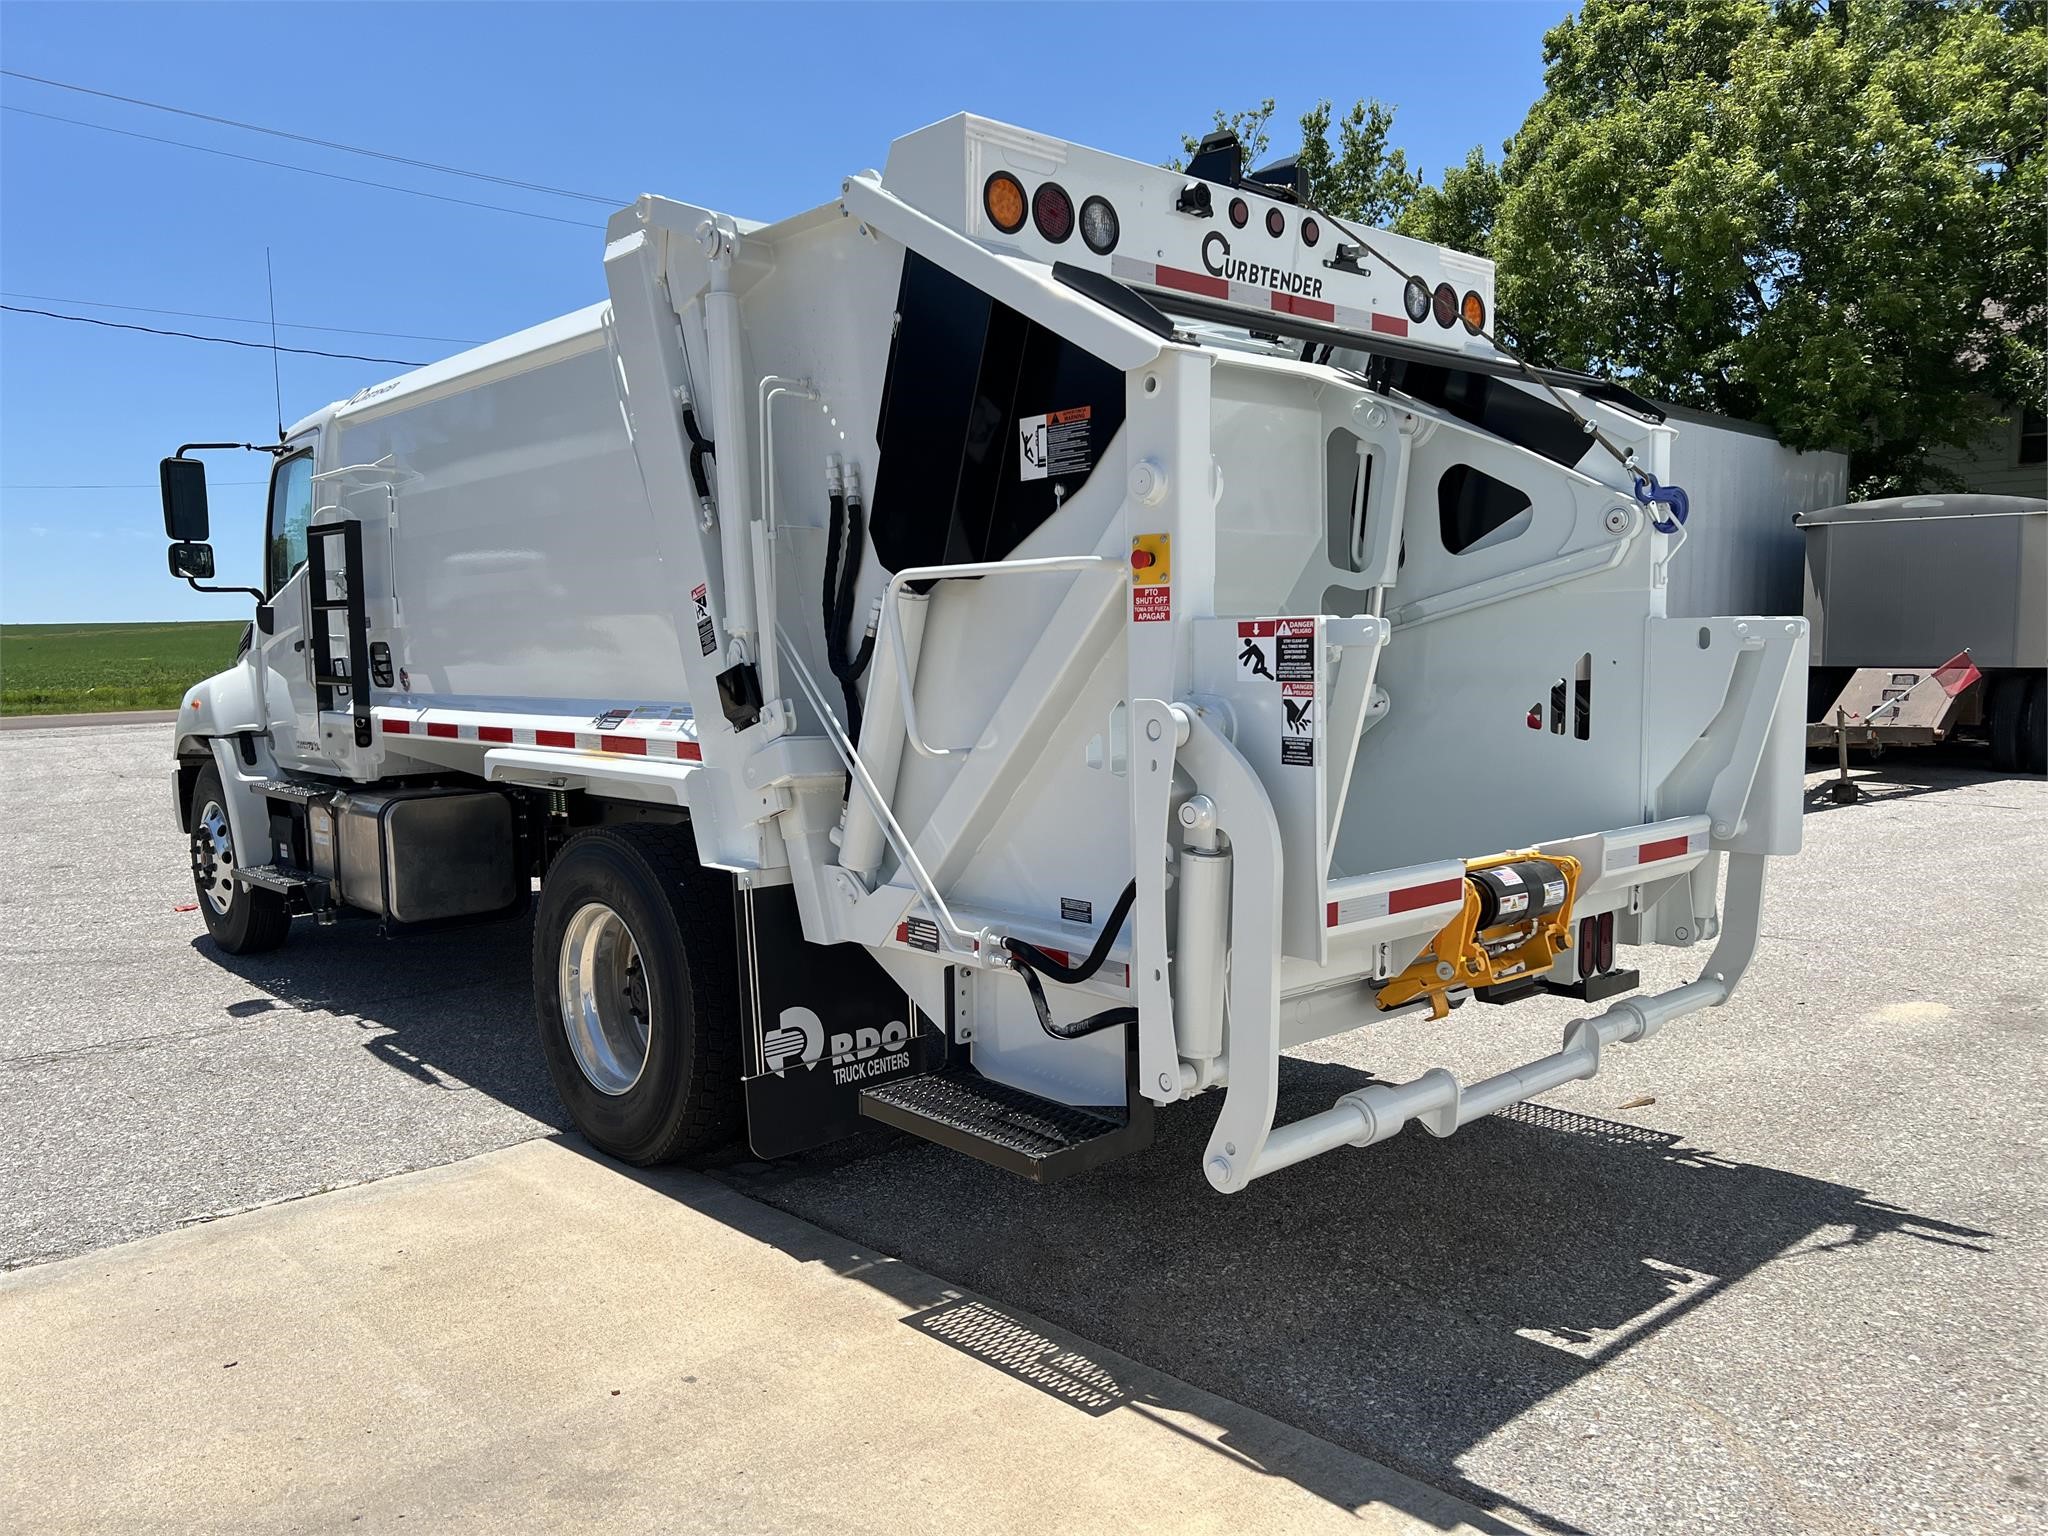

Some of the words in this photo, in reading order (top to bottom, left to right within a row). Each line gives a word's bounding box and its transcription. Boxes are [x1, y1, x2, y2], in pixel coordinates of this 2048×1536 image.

[1201, 230, 1323, 299] CURBTENDER
[1135, 597, 1153, 605] SHUT
[1154, 596, 1168, 604] OFF
[1144, 588, 1158, 596] PTO
[1137, 612, 1166, 621] APAGAR
[830, 1020, 908, 1066] RDO
[832, 1063, 867, 1086] TRUCK
[867, 1051, 910, 1076] CENTERS
